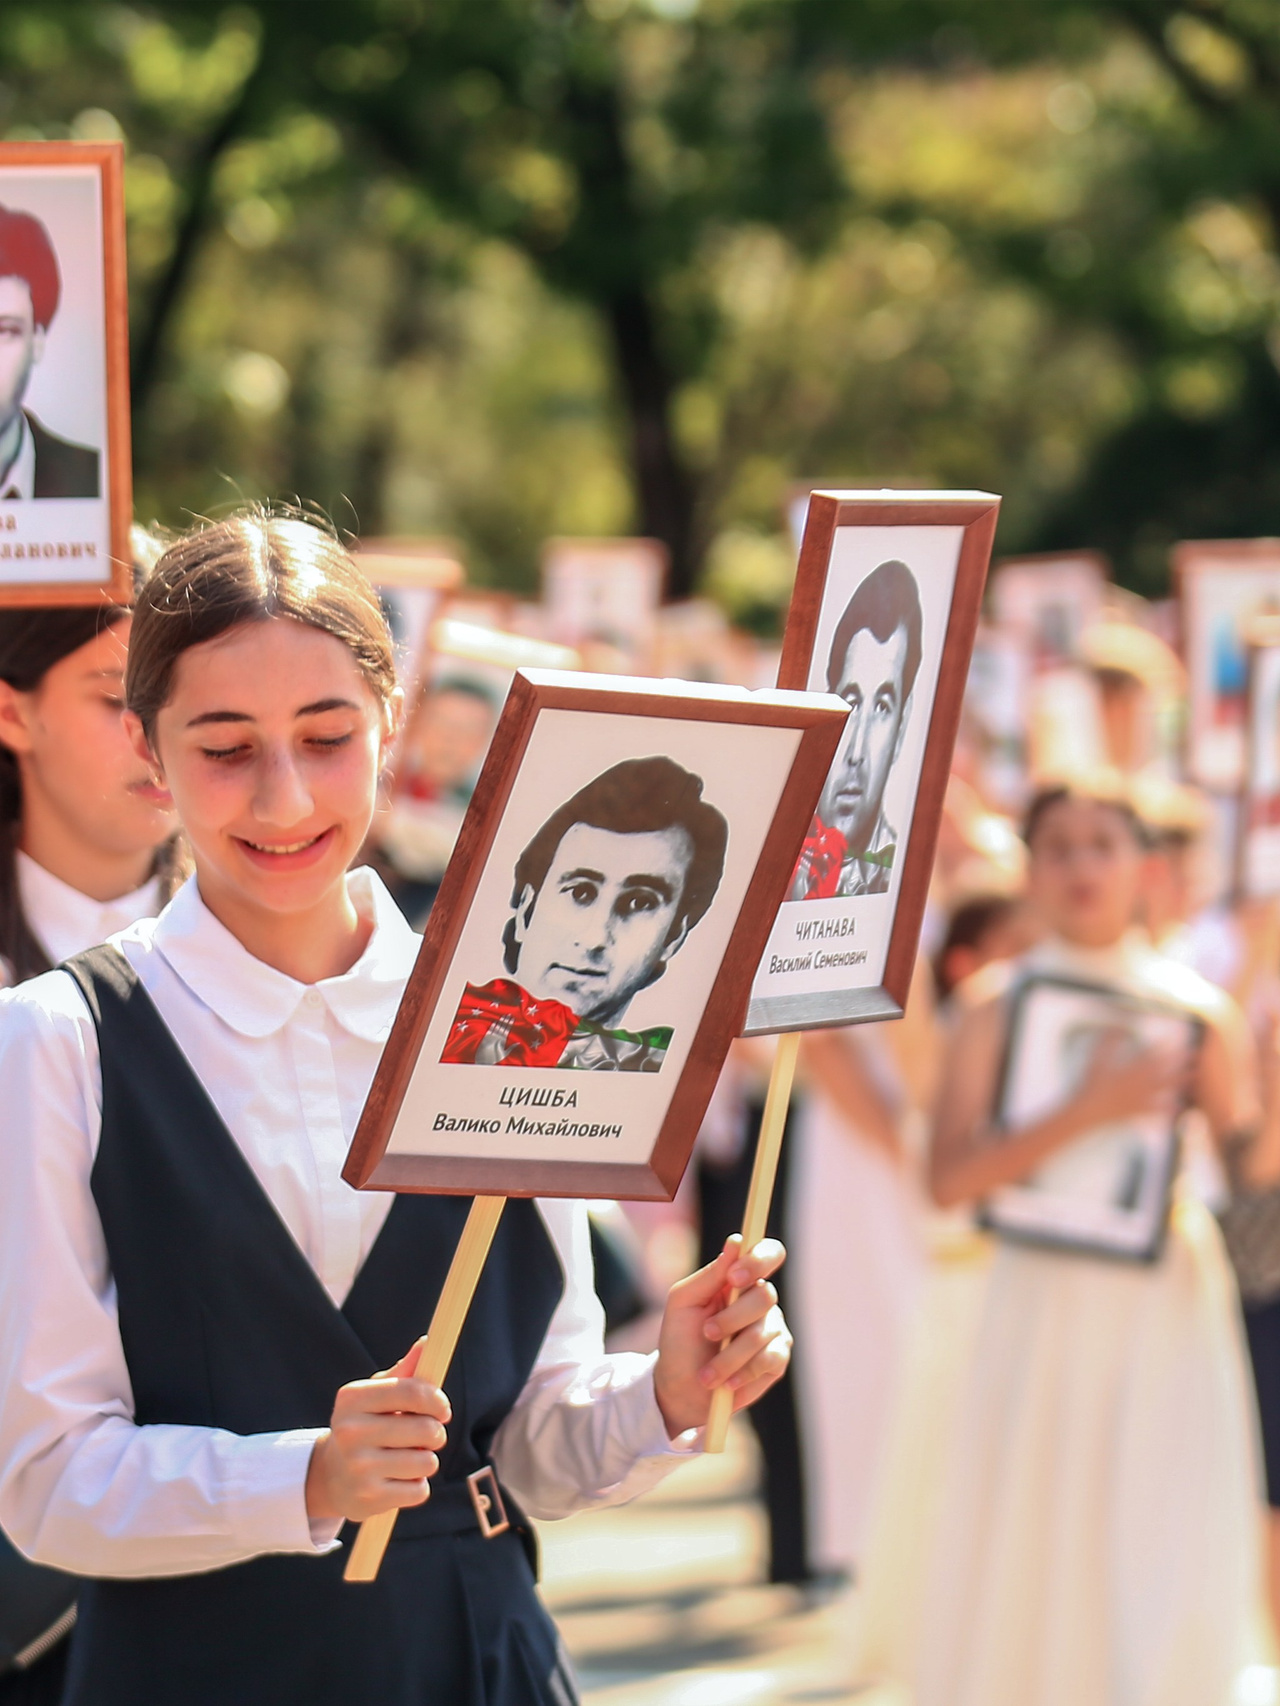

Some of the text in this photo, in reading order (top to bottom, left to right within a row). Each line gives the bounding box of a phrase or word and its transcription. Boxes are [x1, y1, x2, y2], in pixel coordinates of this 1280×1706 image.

[796, 917, 856, 941] ЧИТАНАВА
[769, 950, 868, 975] Василий Семенович
[498, 1086, 578, 1108] ЦИШБА
[432, 1112, 623, 1138] Валико Михайлович
